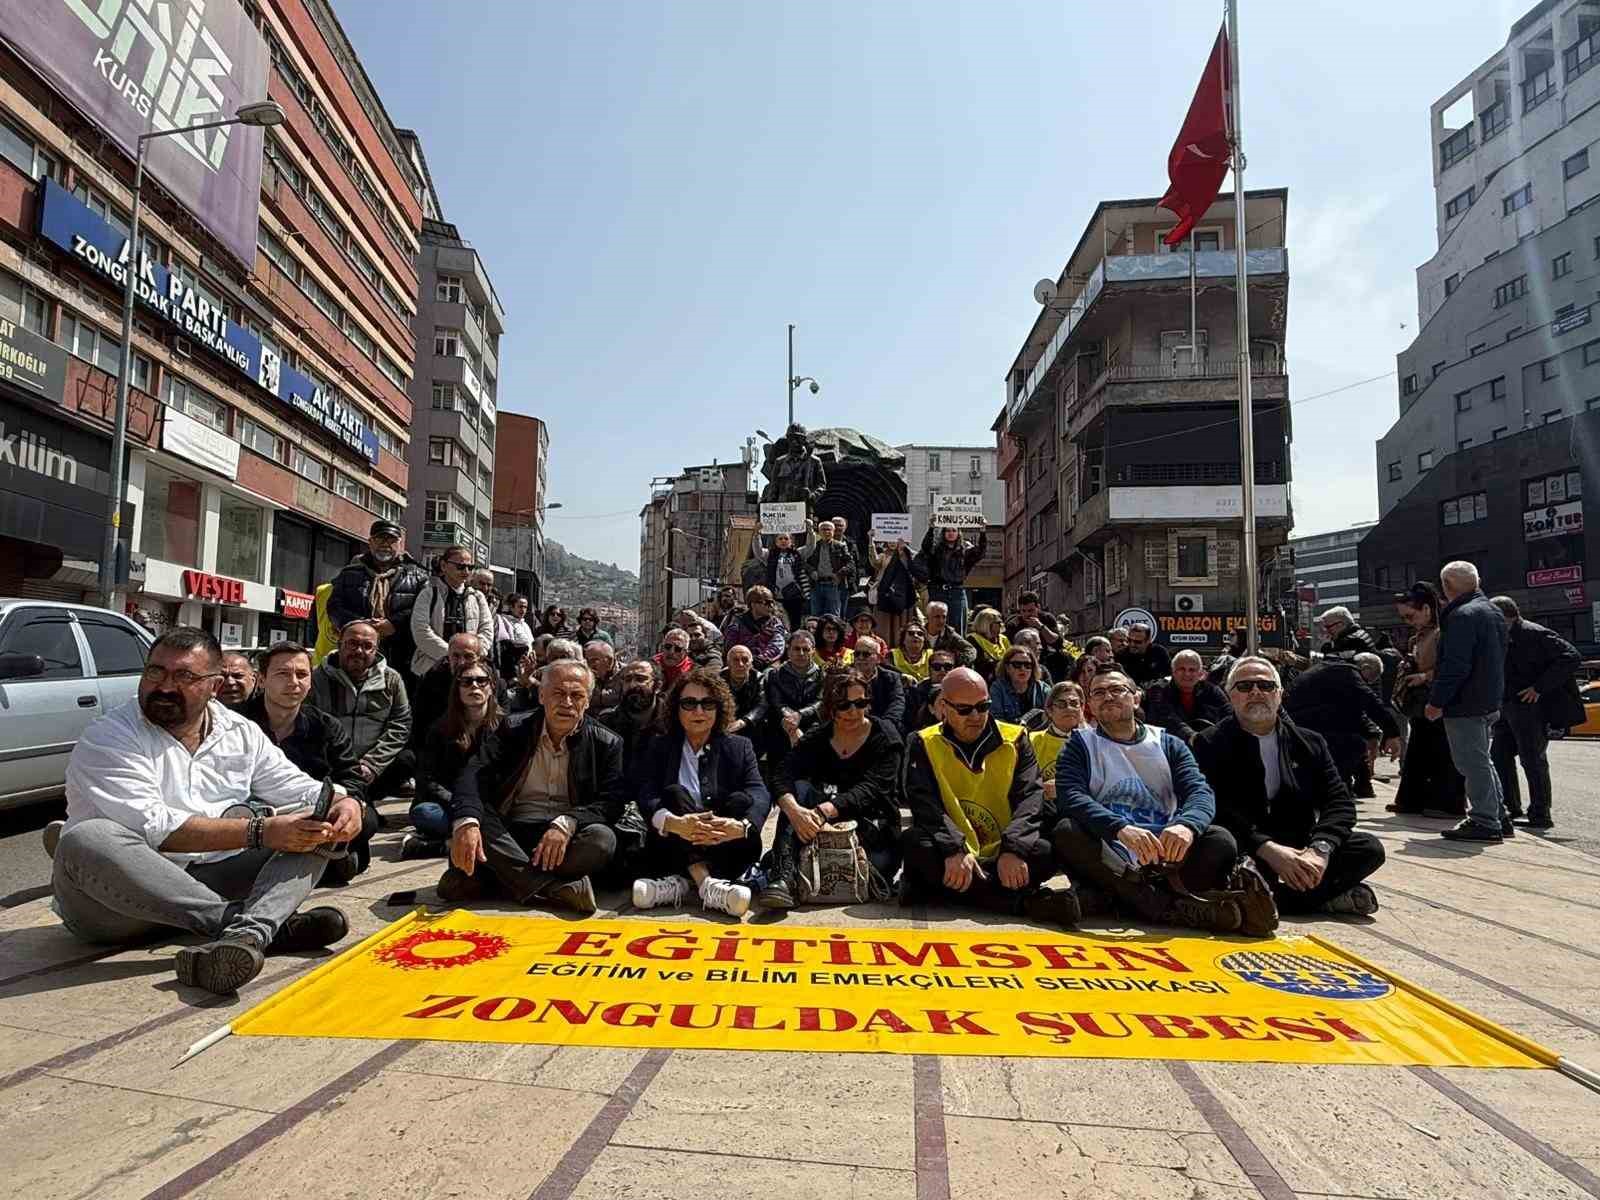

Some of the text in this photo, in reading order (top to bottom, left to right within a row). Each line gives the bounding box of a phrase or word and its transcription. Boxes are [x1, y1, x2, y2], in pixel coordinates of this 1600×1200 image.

[92, 47, 153, 118] KURS
[169, 273, 227, 338] PARTİ
[0, 338, 47, 377] RKOĞLU
[185, 315, 250, 371] BAŞKANLIĞI
[312, 387, 363, 440] AK PARTİ
[184, 570, 247, 604] VESTEL
[1159, 614, 1277, 632] TRABZON EKEĞİ
[543, 927, 1194, 974] EĞİTİMSEN
[526, 961, 1231, 994] EĞİTİM ve BİLİM EMEKÇİLERİ SENDİKASI
[402, 994, 1380, 1045] ZONGULDAK ŞUBESİ
